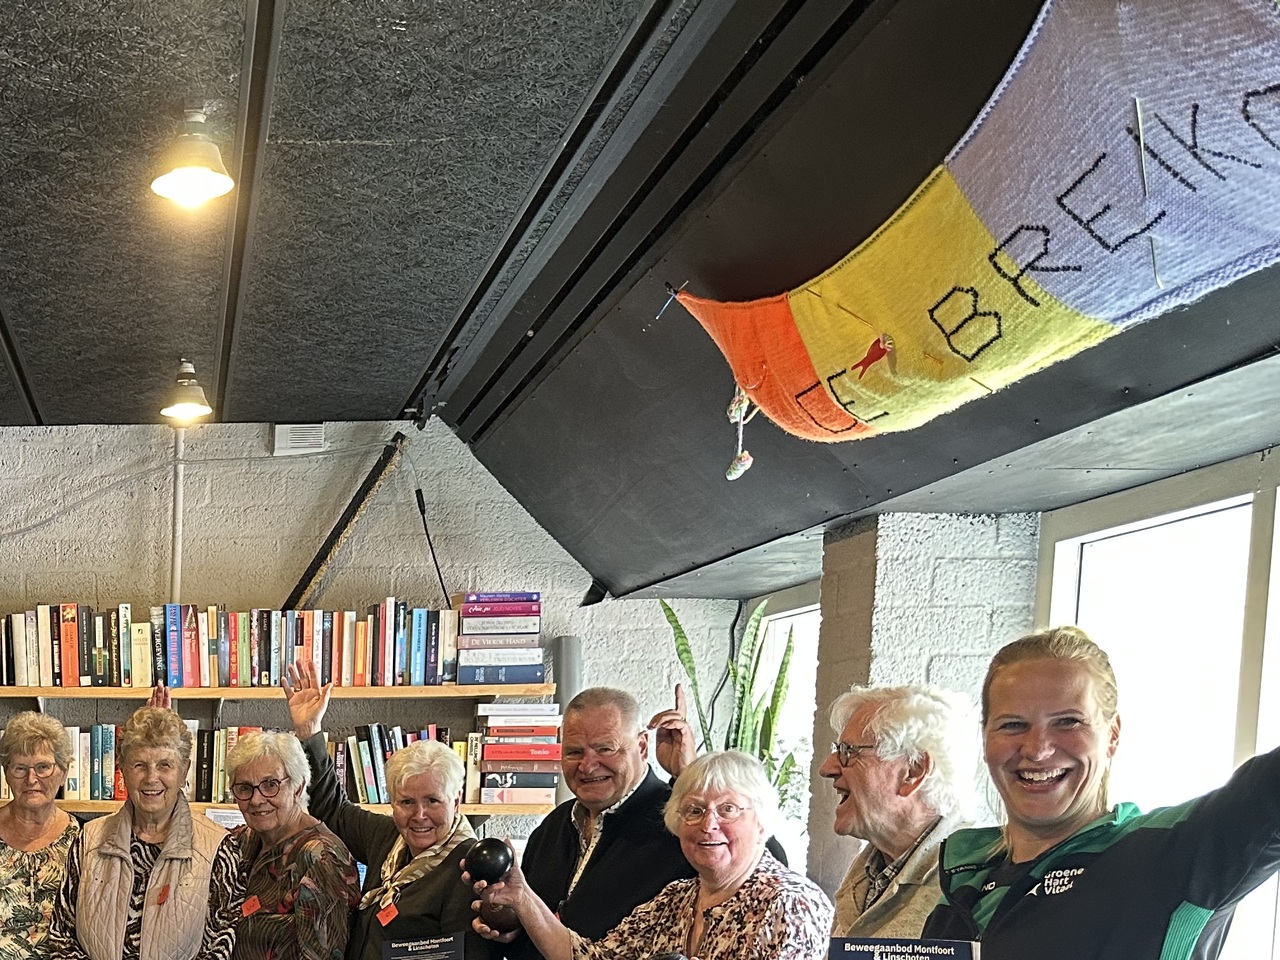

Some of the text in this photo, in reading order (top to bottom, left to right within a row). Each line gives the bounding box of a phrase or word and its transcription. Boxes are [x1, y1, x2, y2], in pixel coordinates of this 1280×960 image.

[506, 637, 526, 645] HAND
[154, 628, 162, 671] VERGEVING
[1043, 876, 1070, 887] Hart
[1044, 881, 1074, 895] Vitaal
[844, 942, 955, 956] Beweegaanbod Montfoort
[873, 952, 881, 960] &
